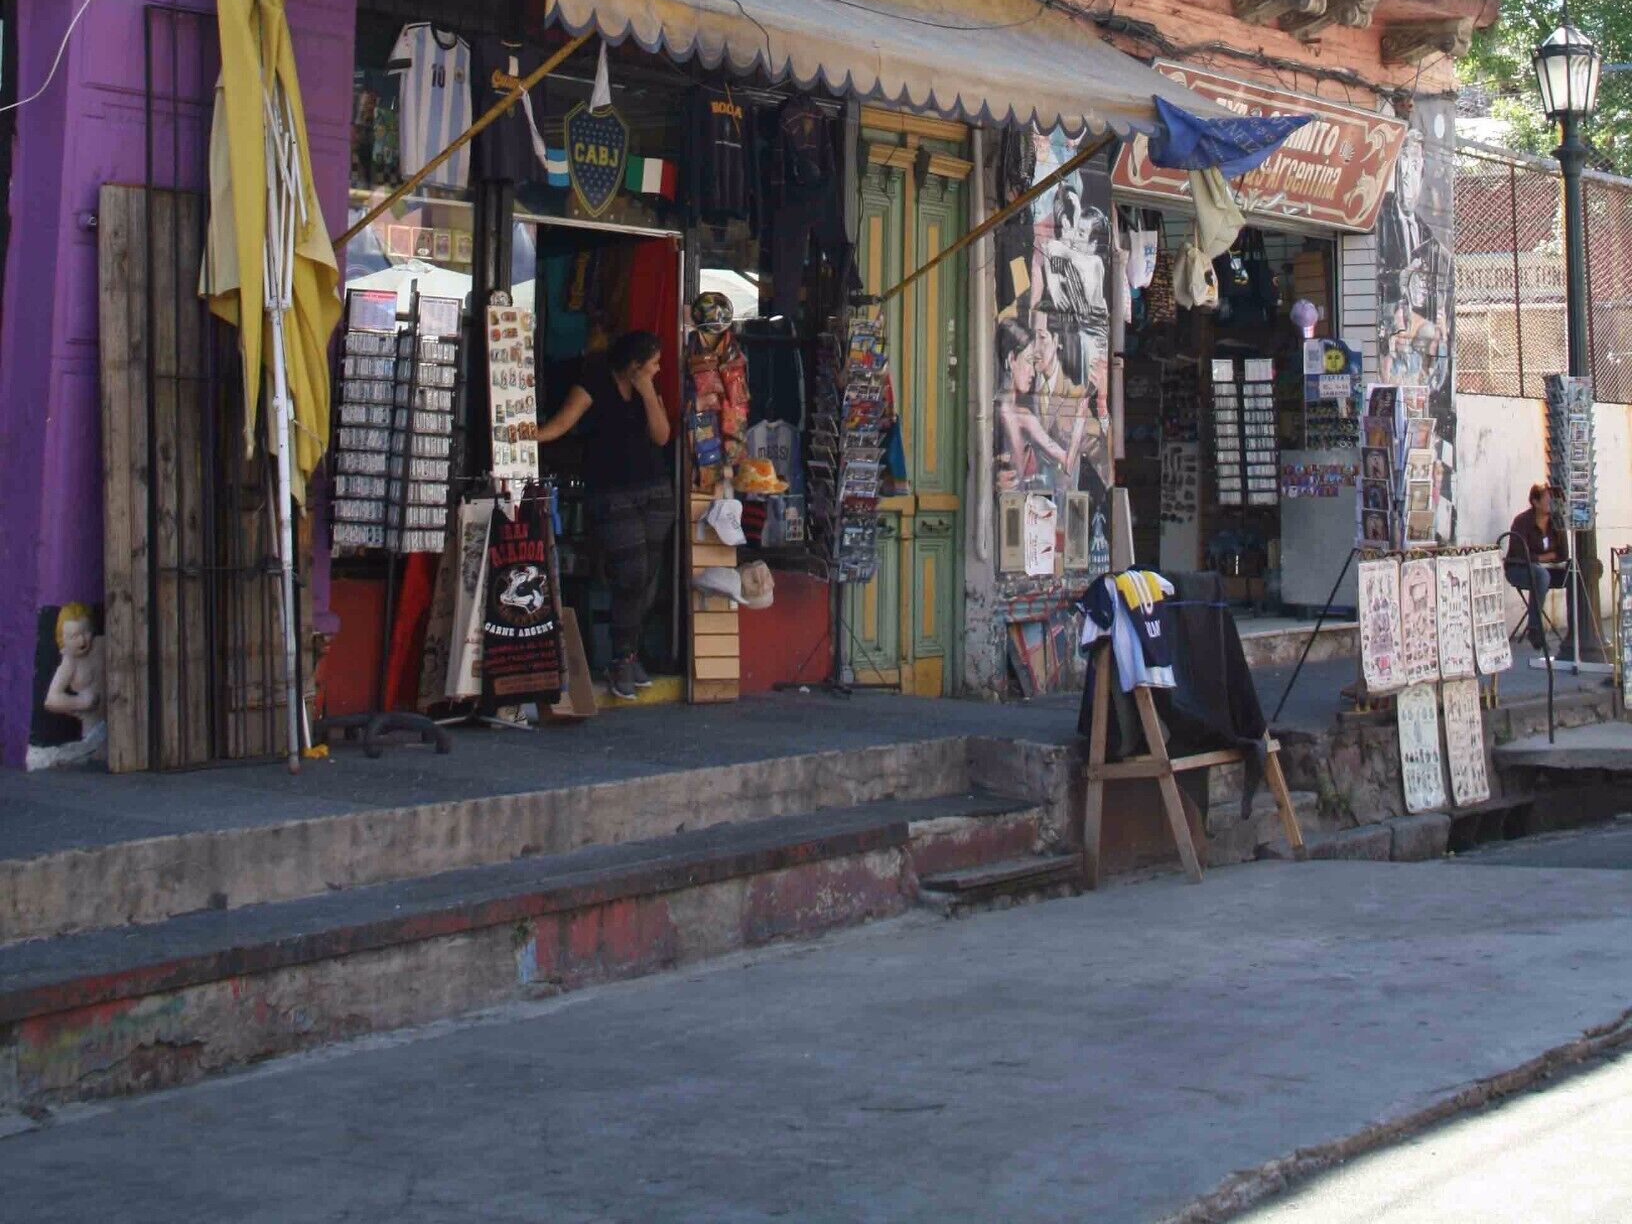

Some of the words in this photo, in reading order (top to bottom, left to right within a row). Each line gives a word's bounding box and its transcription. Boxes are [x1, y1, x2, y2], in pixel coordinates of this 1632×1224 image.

[431, 63, 446, 88] 10
[573, 140, 619, 168] CABJ
[484, 621, 515, 637] CARNE
